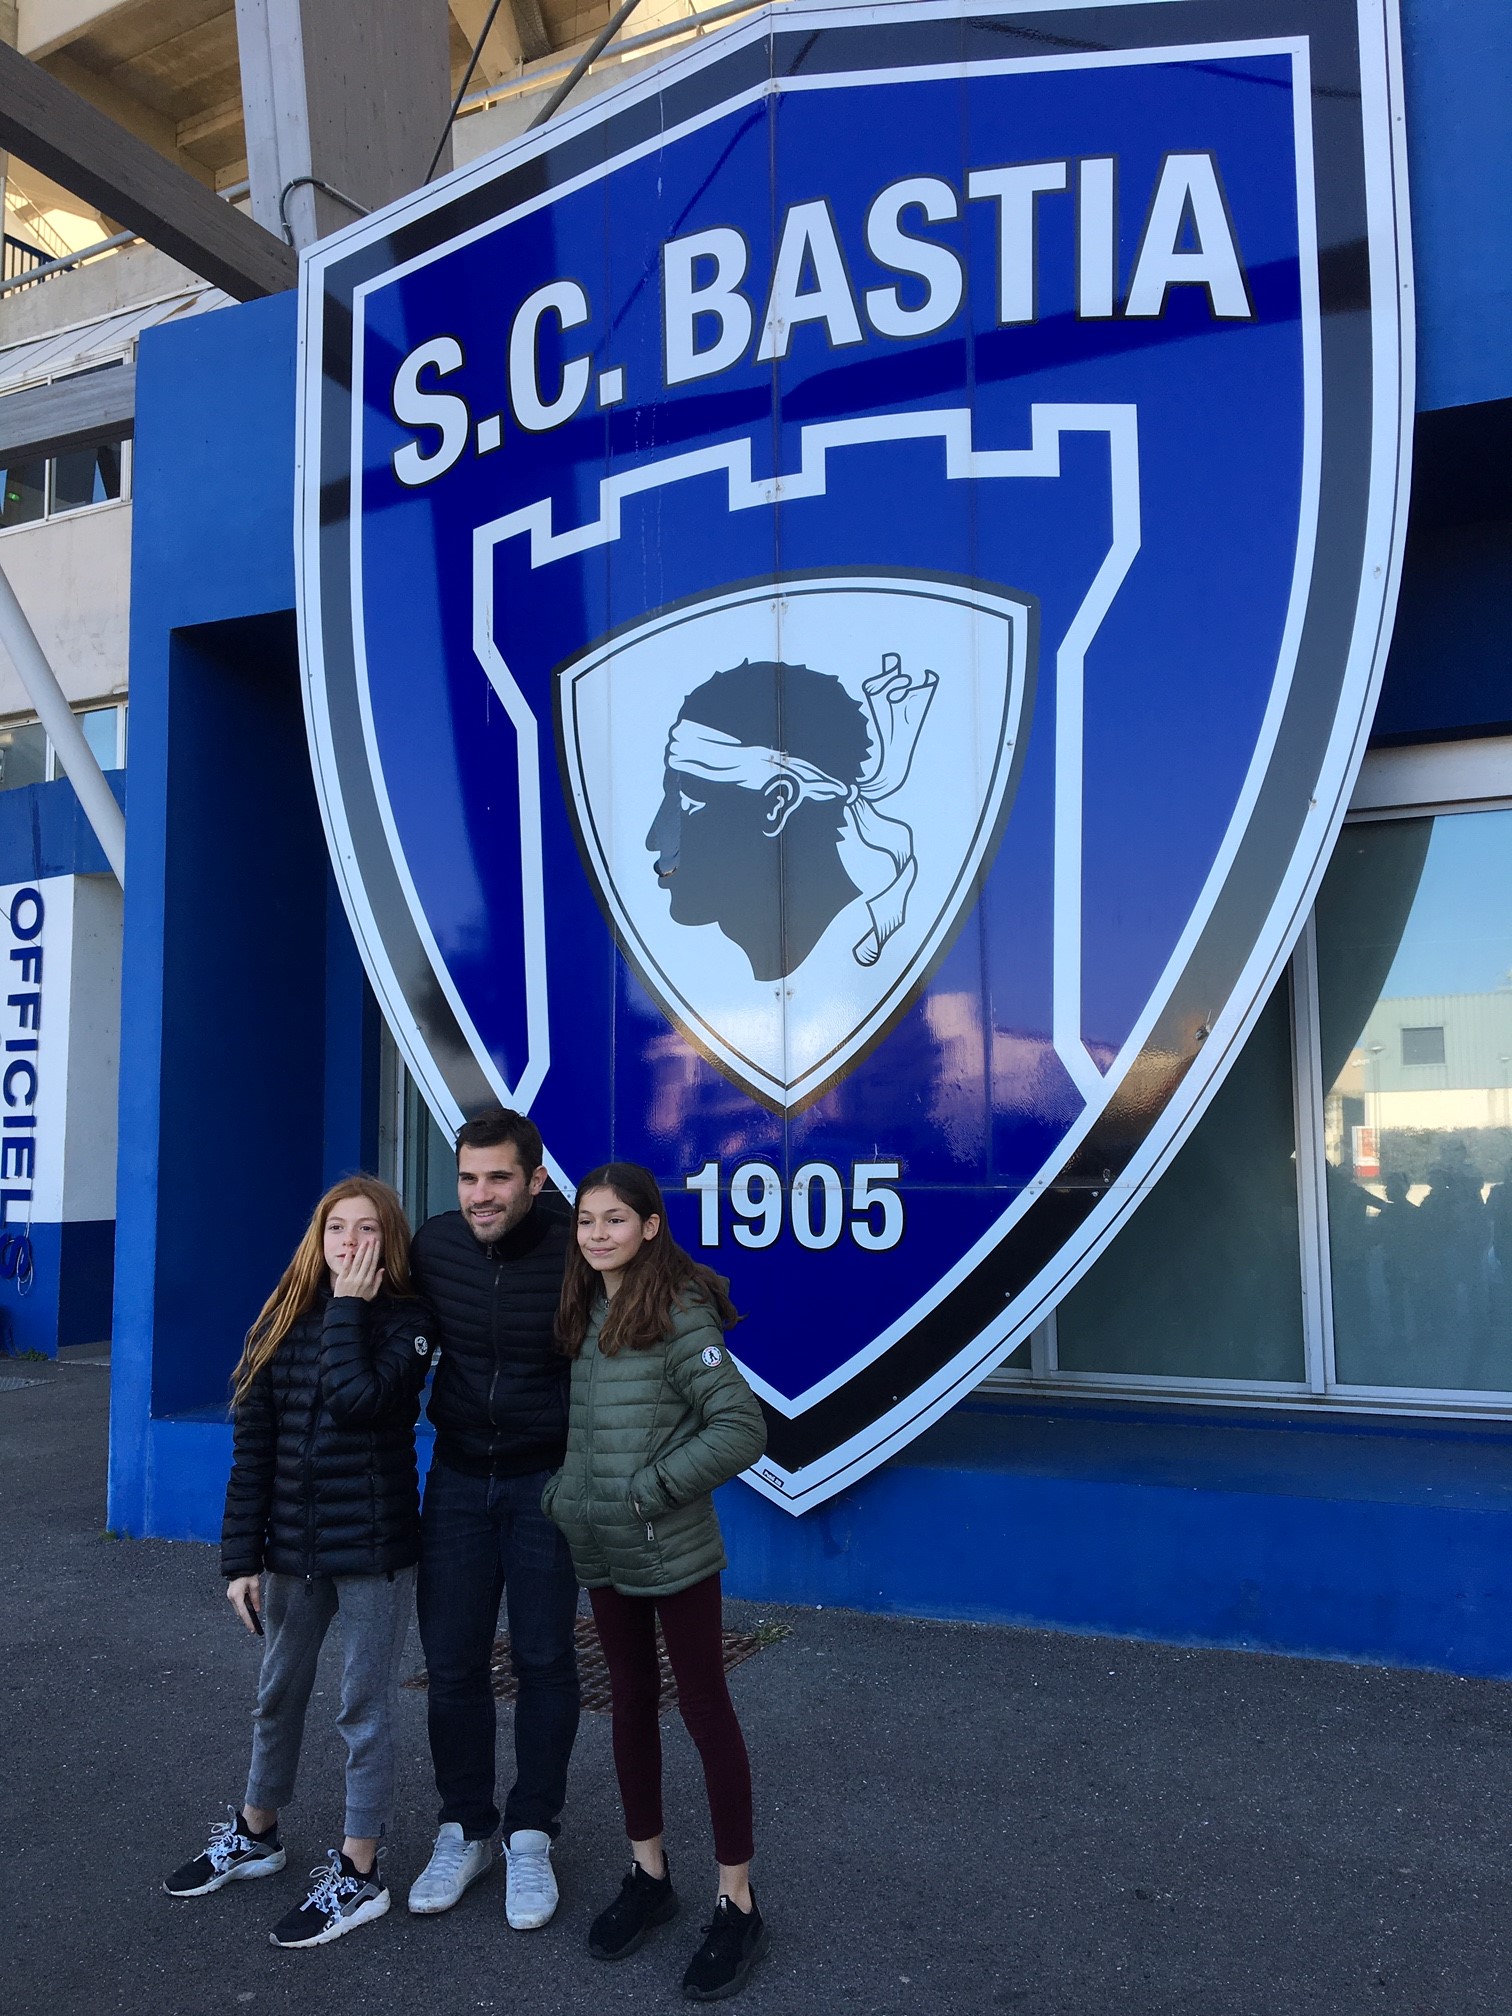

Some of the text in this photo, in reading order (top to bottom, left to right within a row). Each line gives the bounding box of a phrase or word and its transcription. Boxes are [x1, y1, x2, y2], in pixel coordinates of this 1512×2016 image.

[392, 152, 1254, 487] S.C. BASTIA
[685, 1161, 905, 1251] 1905
